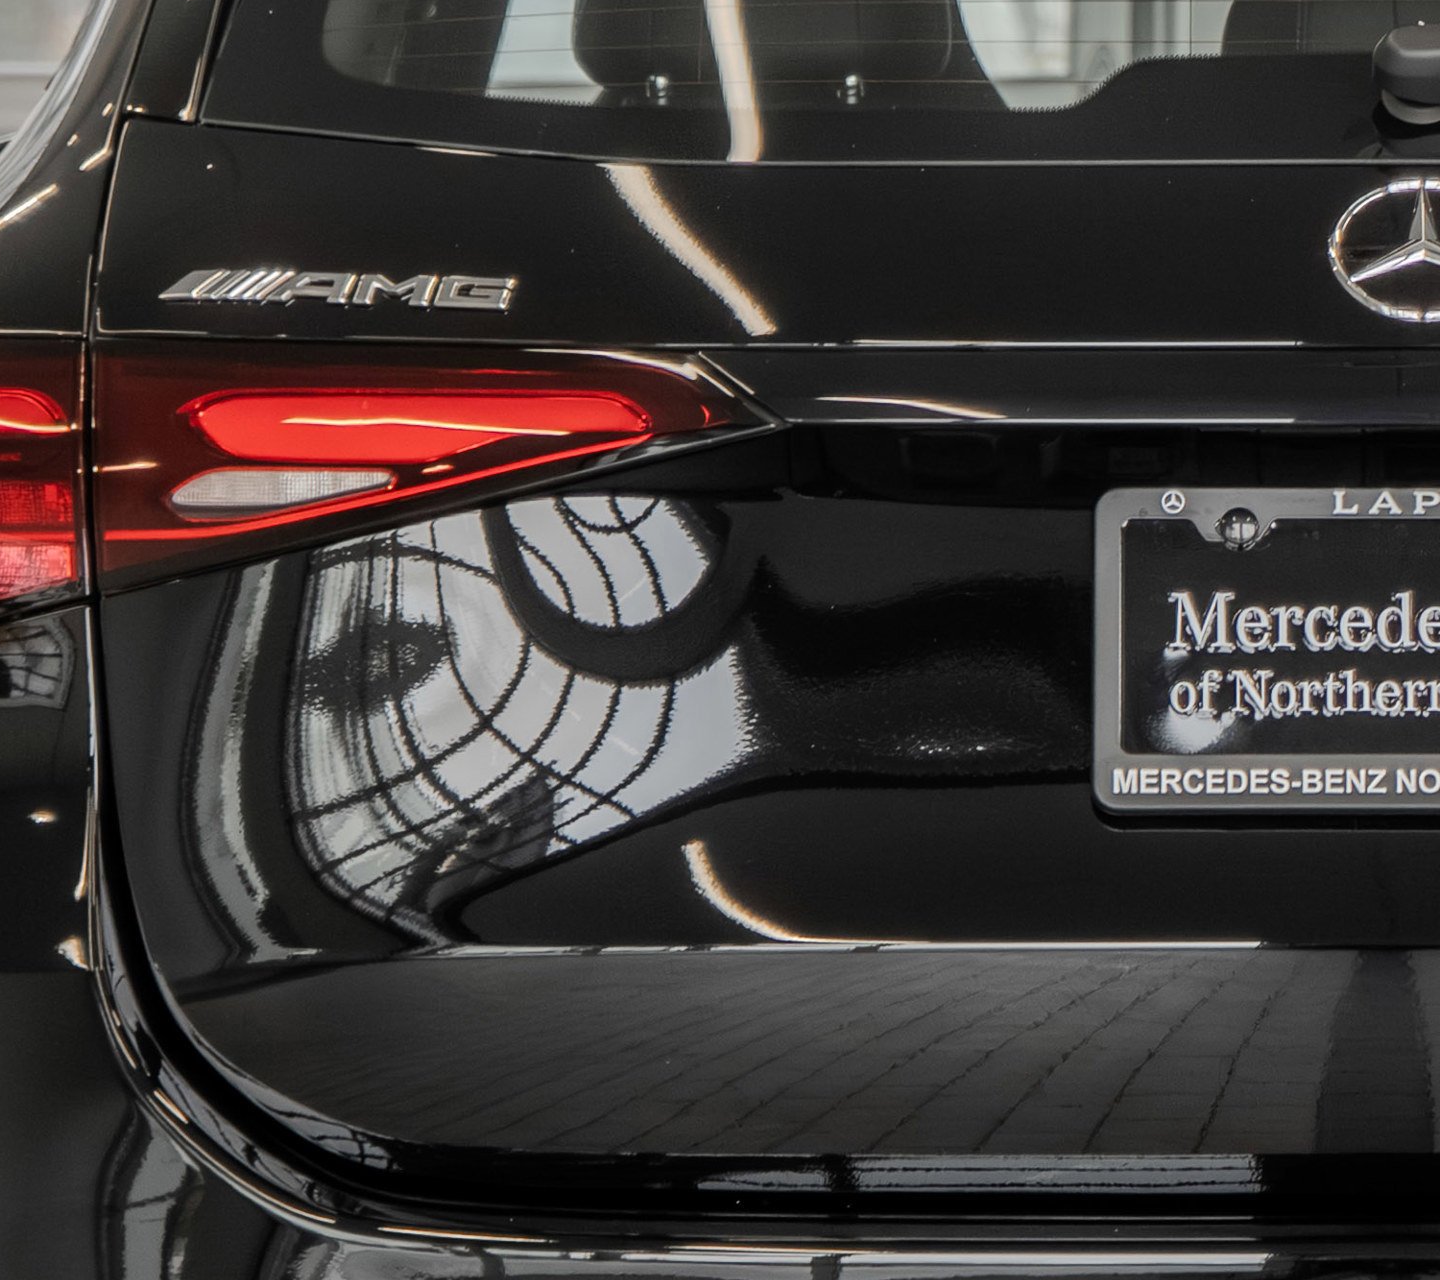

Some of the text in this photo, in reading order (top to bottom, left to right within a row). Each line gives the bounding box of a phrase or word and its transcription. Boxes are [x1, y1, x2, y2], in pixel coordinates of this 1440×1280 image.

[265, 271, 518, 311] AMG
[1168, 671, 1220, 714] of
[1111, 767, 1388, 796] MERCEDES-BENZ
